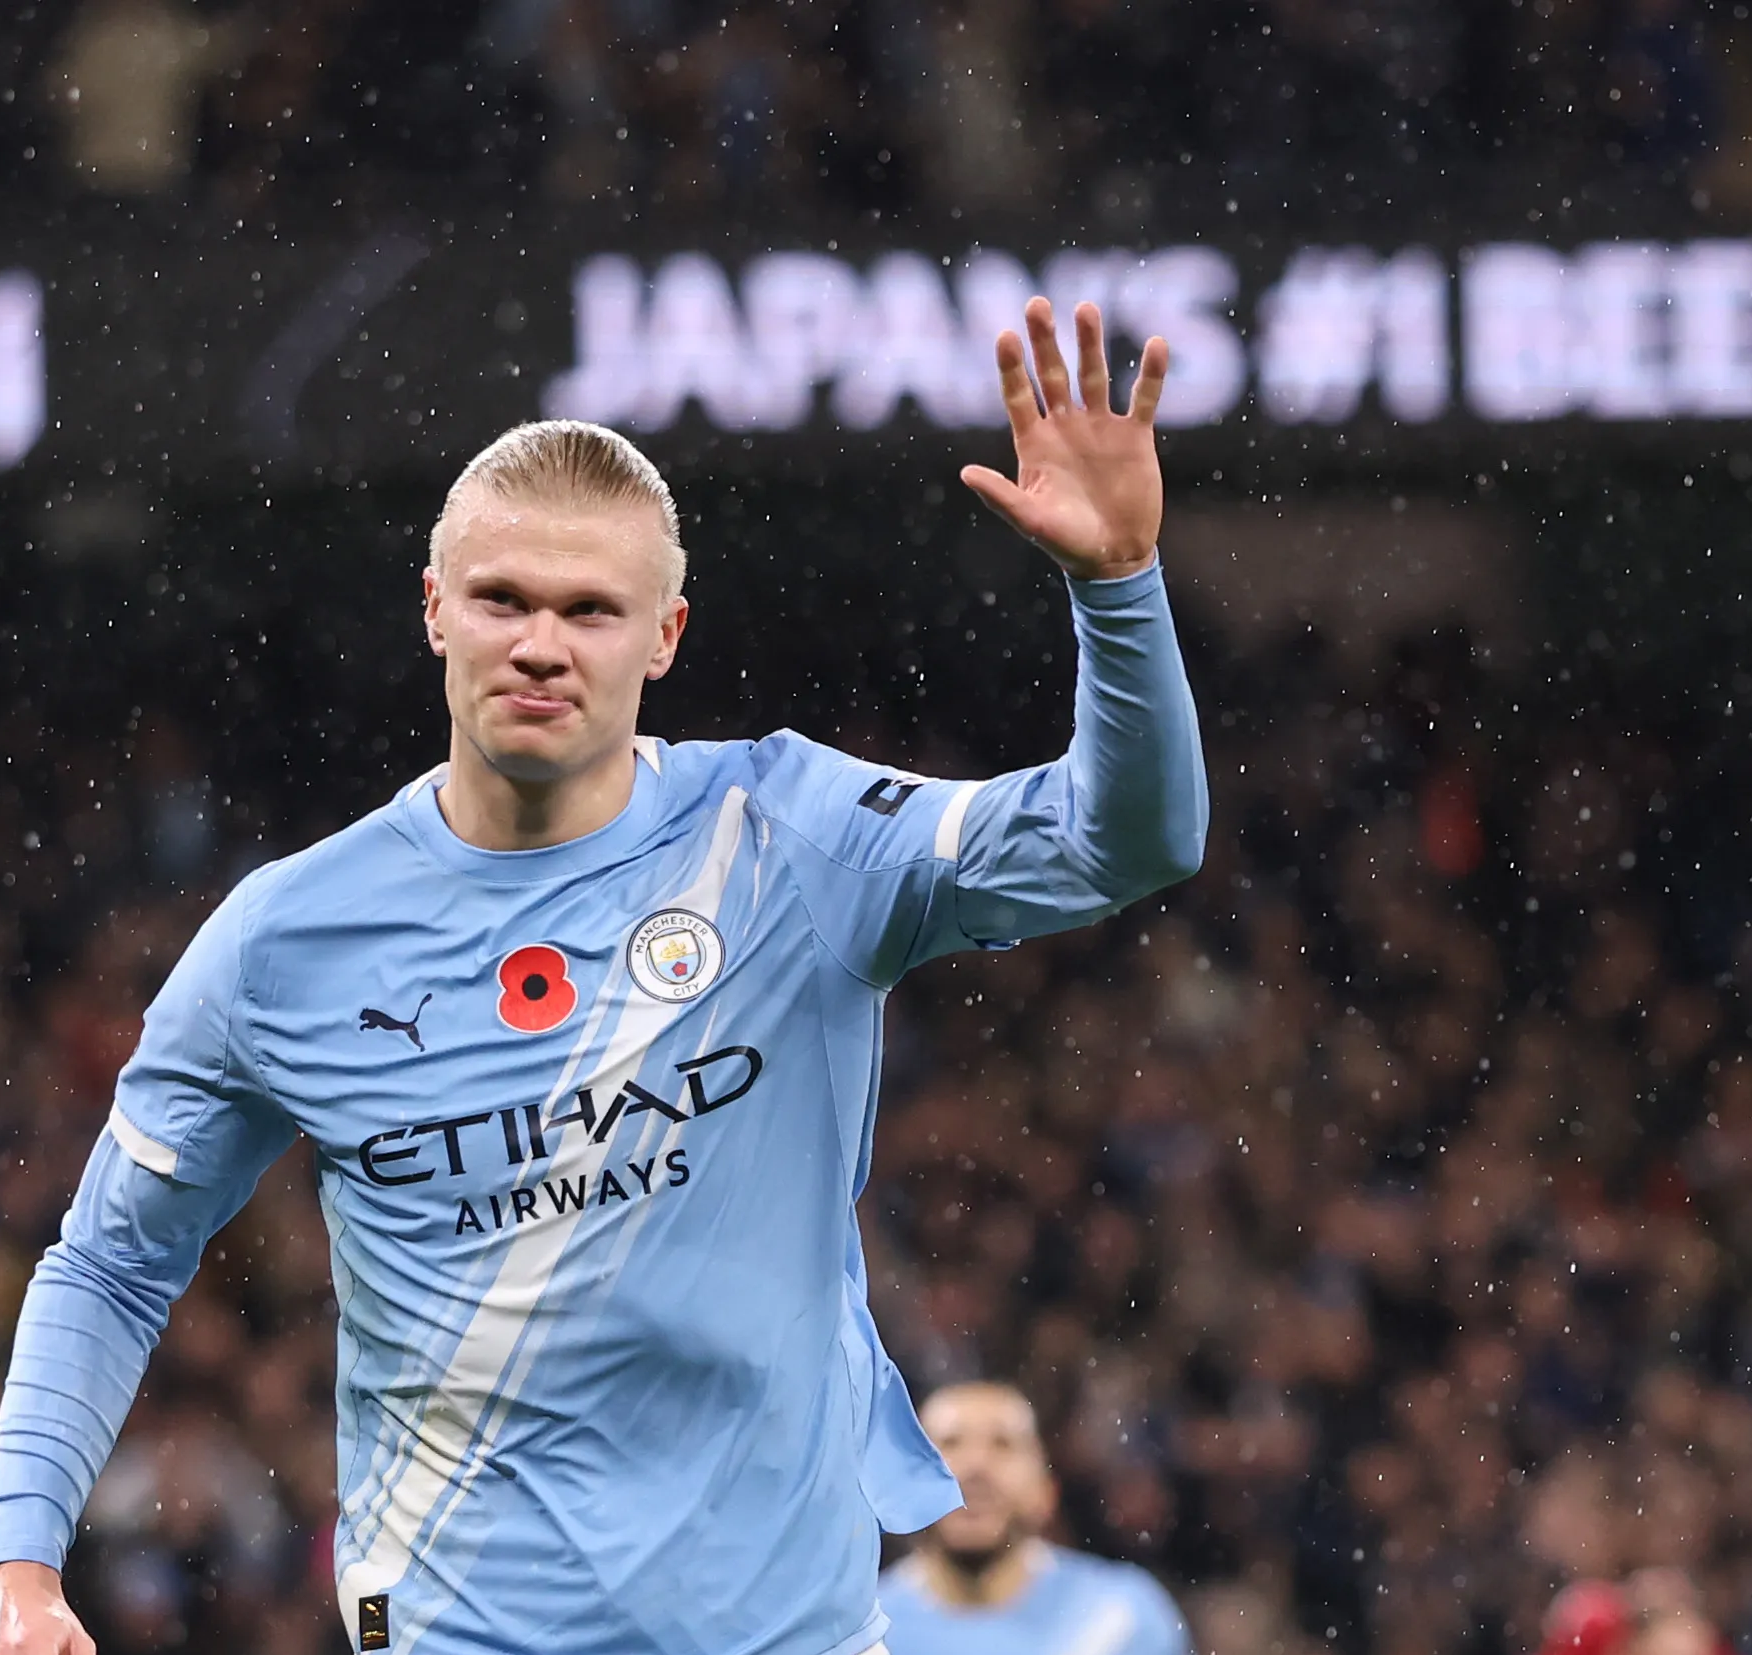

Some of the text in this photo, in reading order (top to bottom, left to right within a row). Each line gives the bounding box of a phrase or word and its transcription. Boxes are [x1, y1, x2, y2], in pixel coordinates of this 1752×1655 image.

[1254, 242, 1449, 424] #1
[635, 916, 708, 954] MANCHESTER
[673, 982, 700, 997] CITY
[358, 1044, 764, 1187] ETIHAD
[455, 1149, 691, 1236] AIRWAYS
